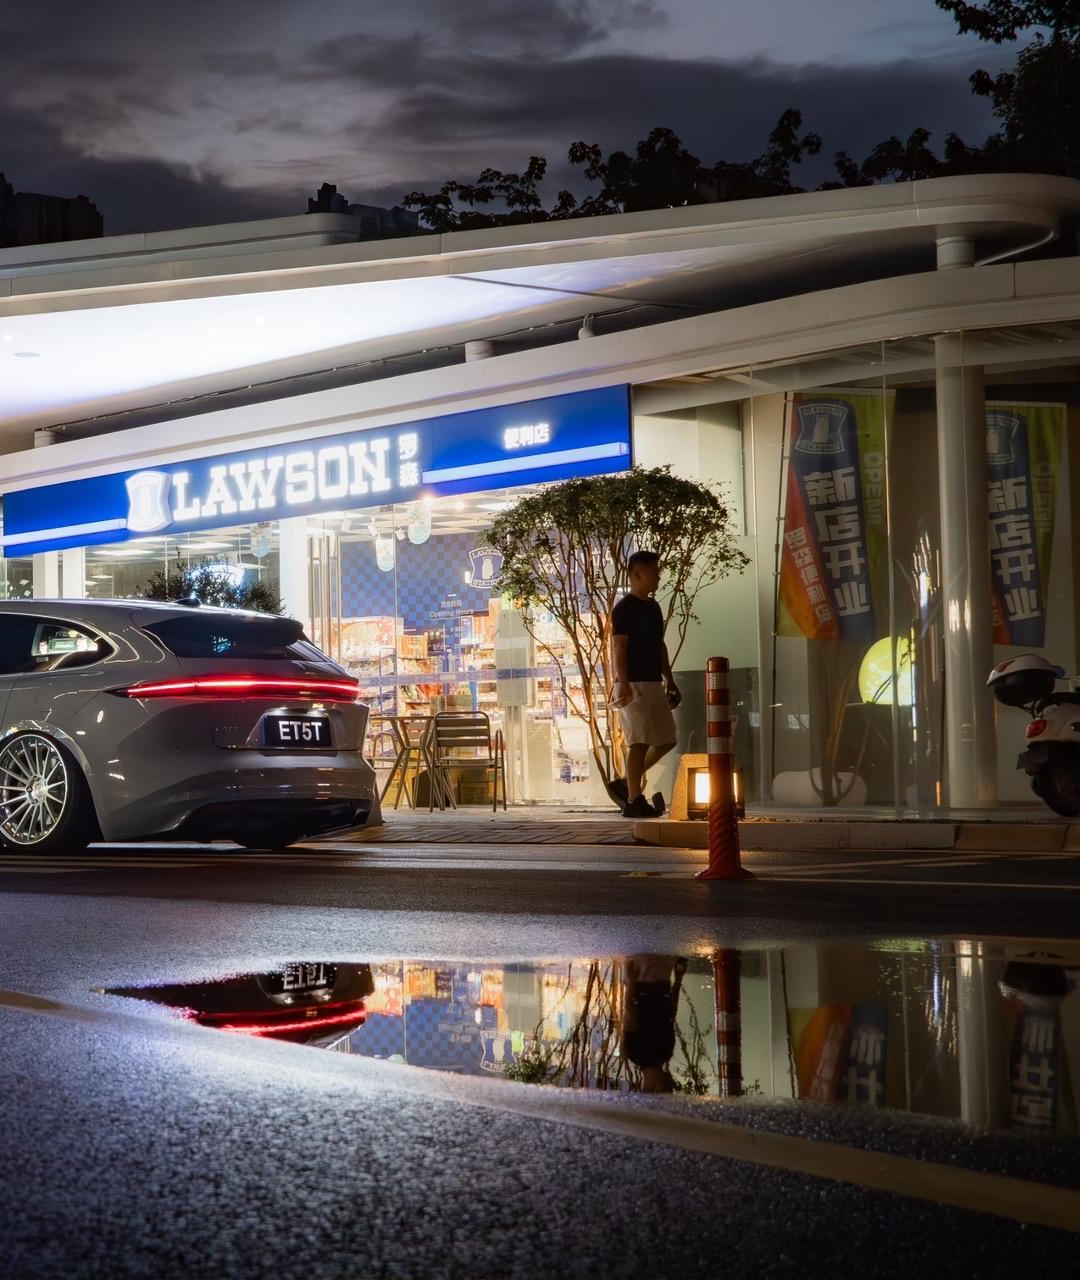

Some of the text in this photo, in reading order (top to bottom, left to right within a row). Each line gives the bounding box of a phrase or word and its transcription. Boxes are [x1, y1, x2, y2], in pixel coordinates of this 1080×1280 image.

[504, 423, 550, 449] 便利店
[172, 438, 392, 521] LAWSON
[398, 433, 419, 488] 罗森
[803, 467, 870, 616] 新店开业
[430, 608, 474, 619] Opening Hours
[279, 721, 322, 740] ET5T
